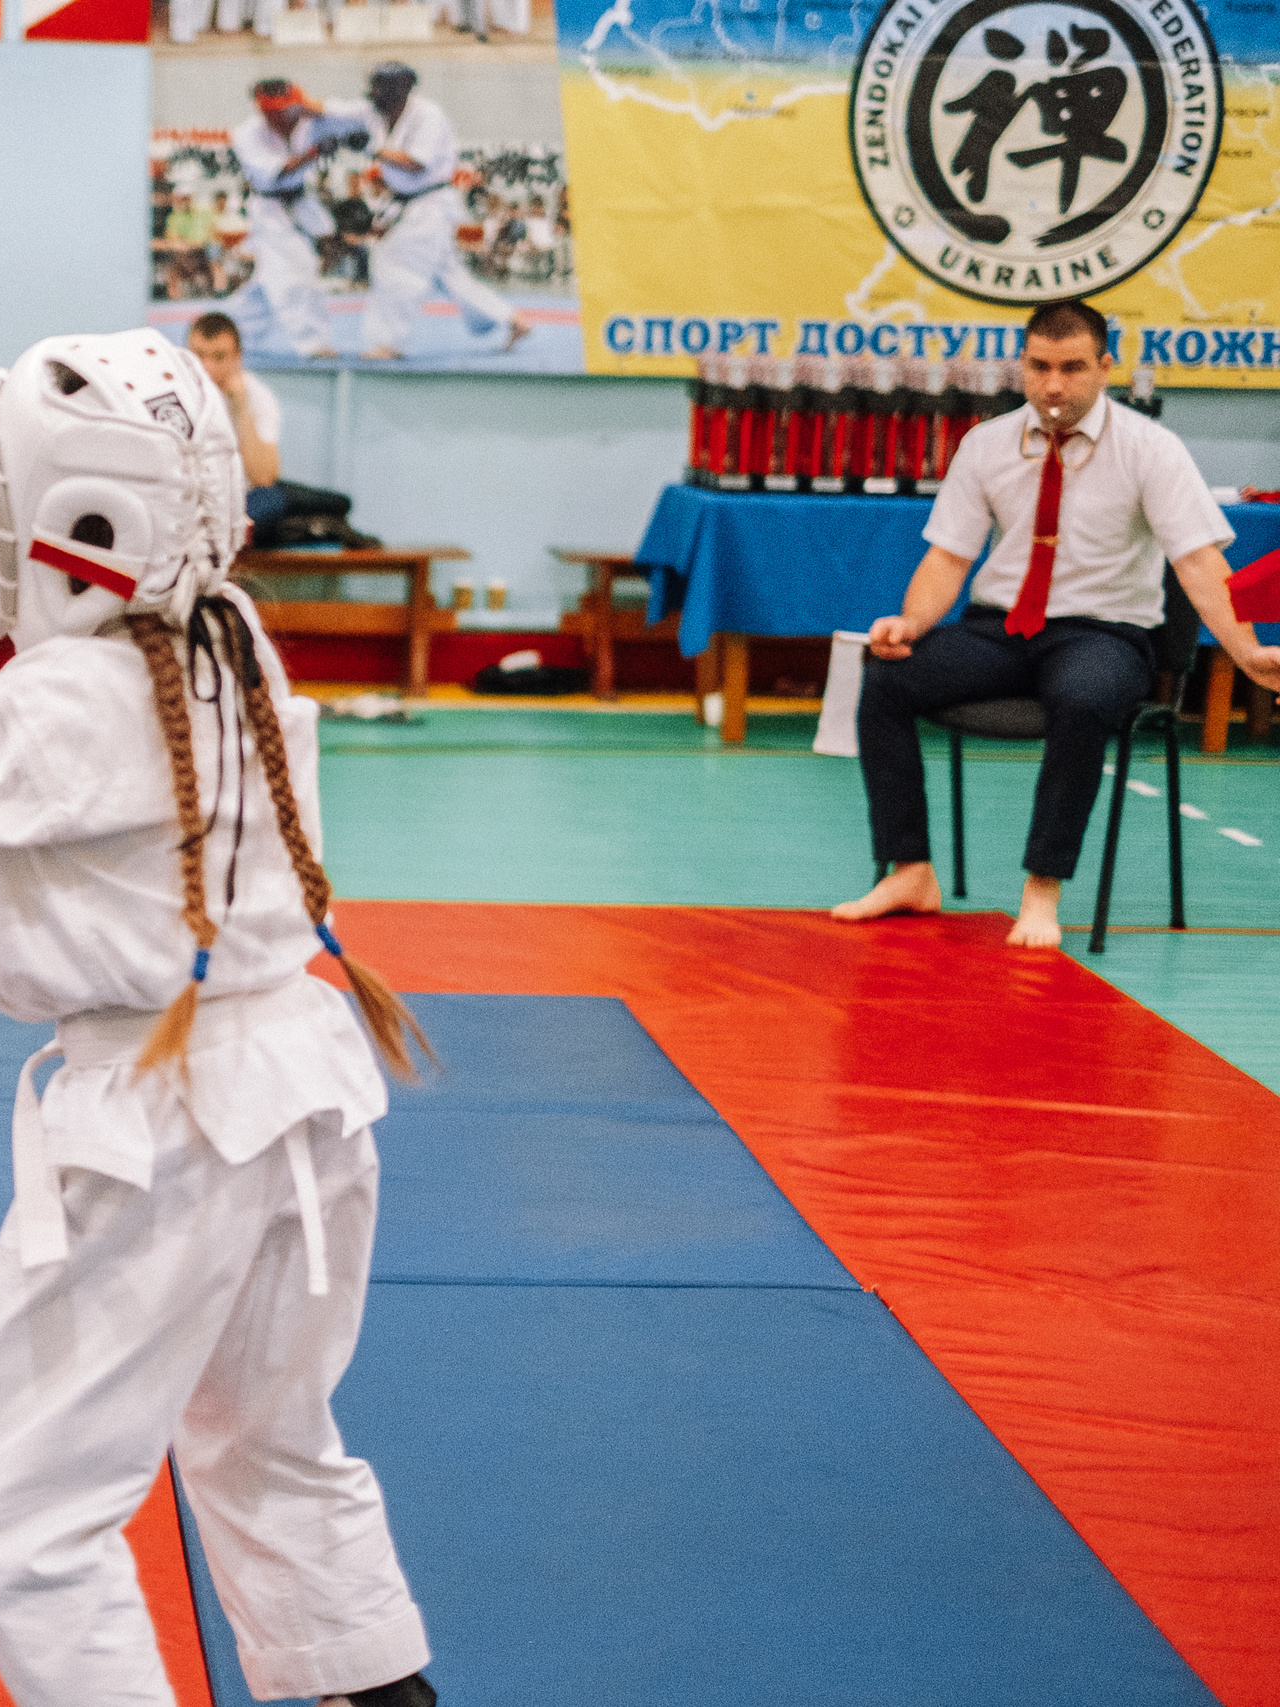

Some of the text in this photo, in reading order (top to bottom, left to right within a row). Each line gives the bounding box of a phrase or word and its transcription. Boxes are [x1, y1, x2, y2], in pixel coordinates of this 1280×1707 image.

[865, 5, 923, 168] ZENDOKAI
[939, 246, 1118, 288] UKRAINE
[605, 317, 778, 354] СПОРТ
